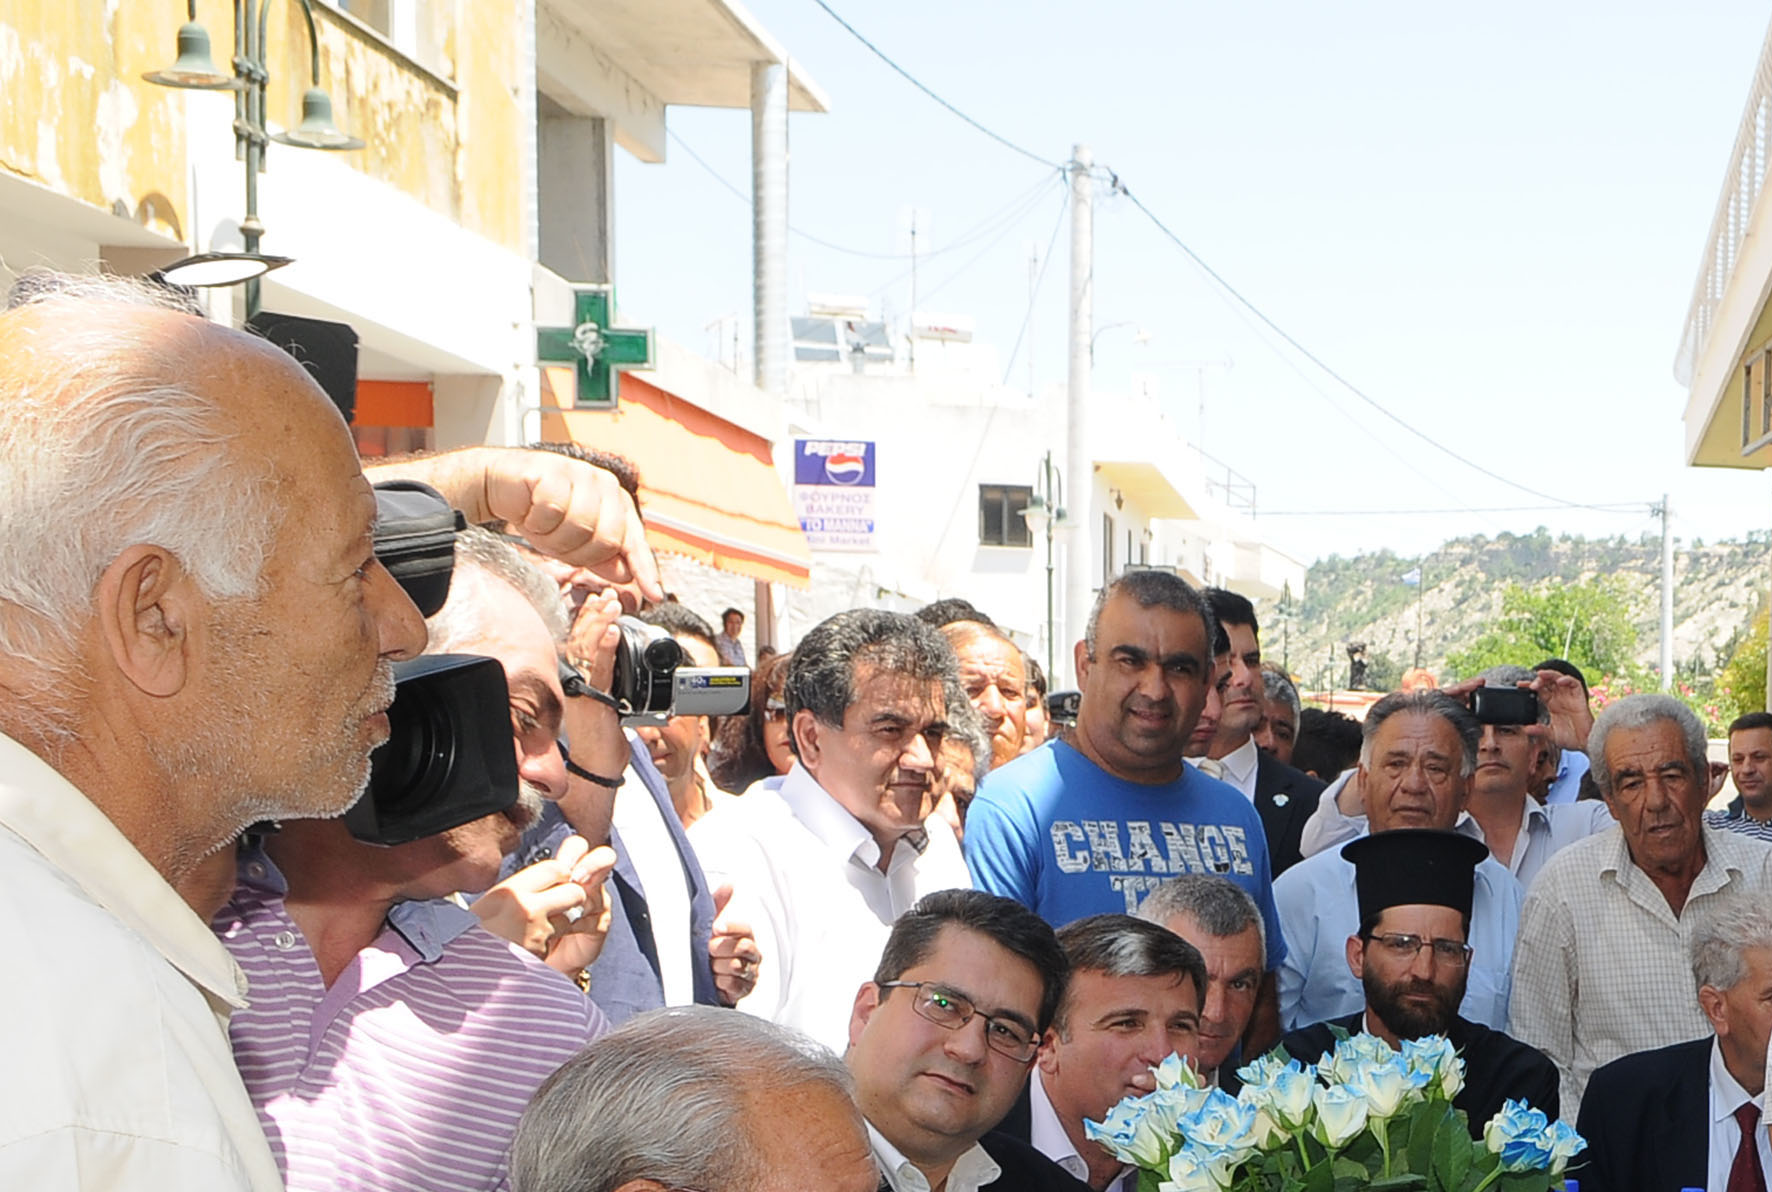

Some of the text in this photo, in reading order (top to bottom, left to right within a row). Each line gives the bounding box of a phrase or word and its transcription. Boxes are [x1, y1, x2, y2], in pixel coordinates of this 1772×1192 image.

[804, 441, 866, 456] PEPSI
[805, 504, 864, 516] BAKERY
[1050, 820, 1254, 875] CHANGE
